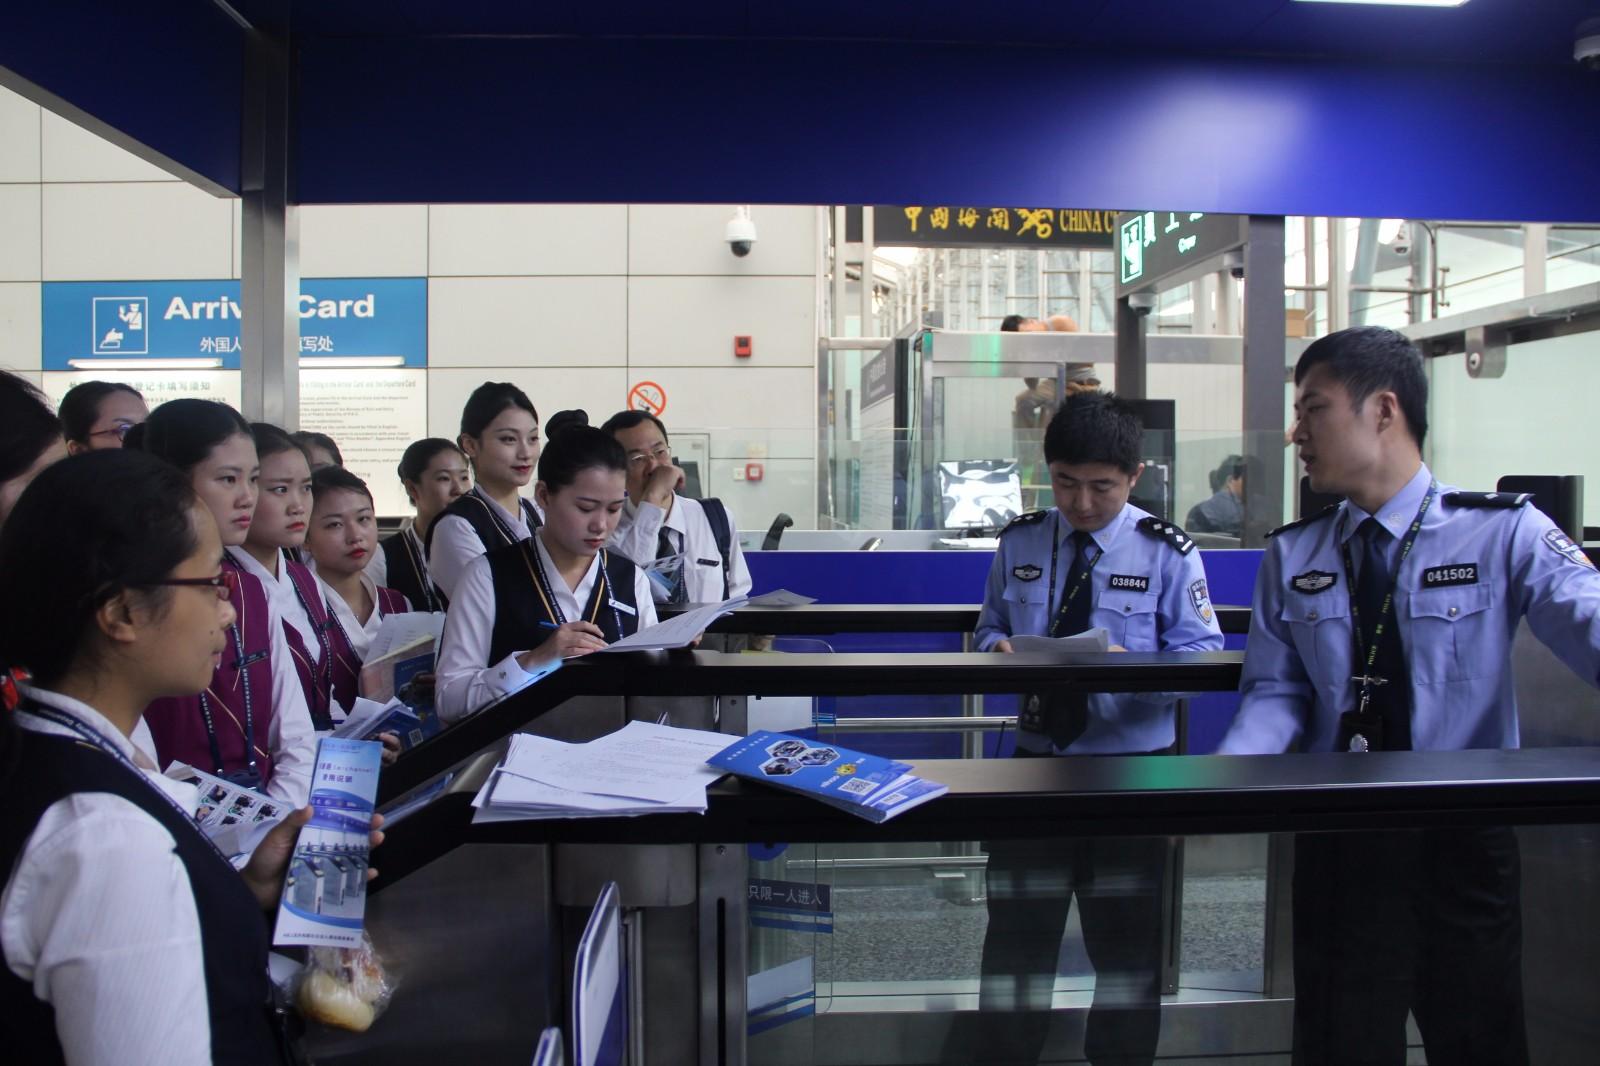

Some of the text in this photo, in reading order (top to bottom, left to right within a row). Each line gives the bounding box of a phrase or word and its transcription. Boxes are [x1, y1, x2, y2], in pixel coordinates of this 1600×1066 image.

[1059, 209, 1119, 233] CHINA C
[163, 294, 375, 320] Arriv Card
[1112, 576, 1146, 589] 038844
[1427, 567, 1475, 583] 041502
[747, 884, 822, 905] 只限一人进入
